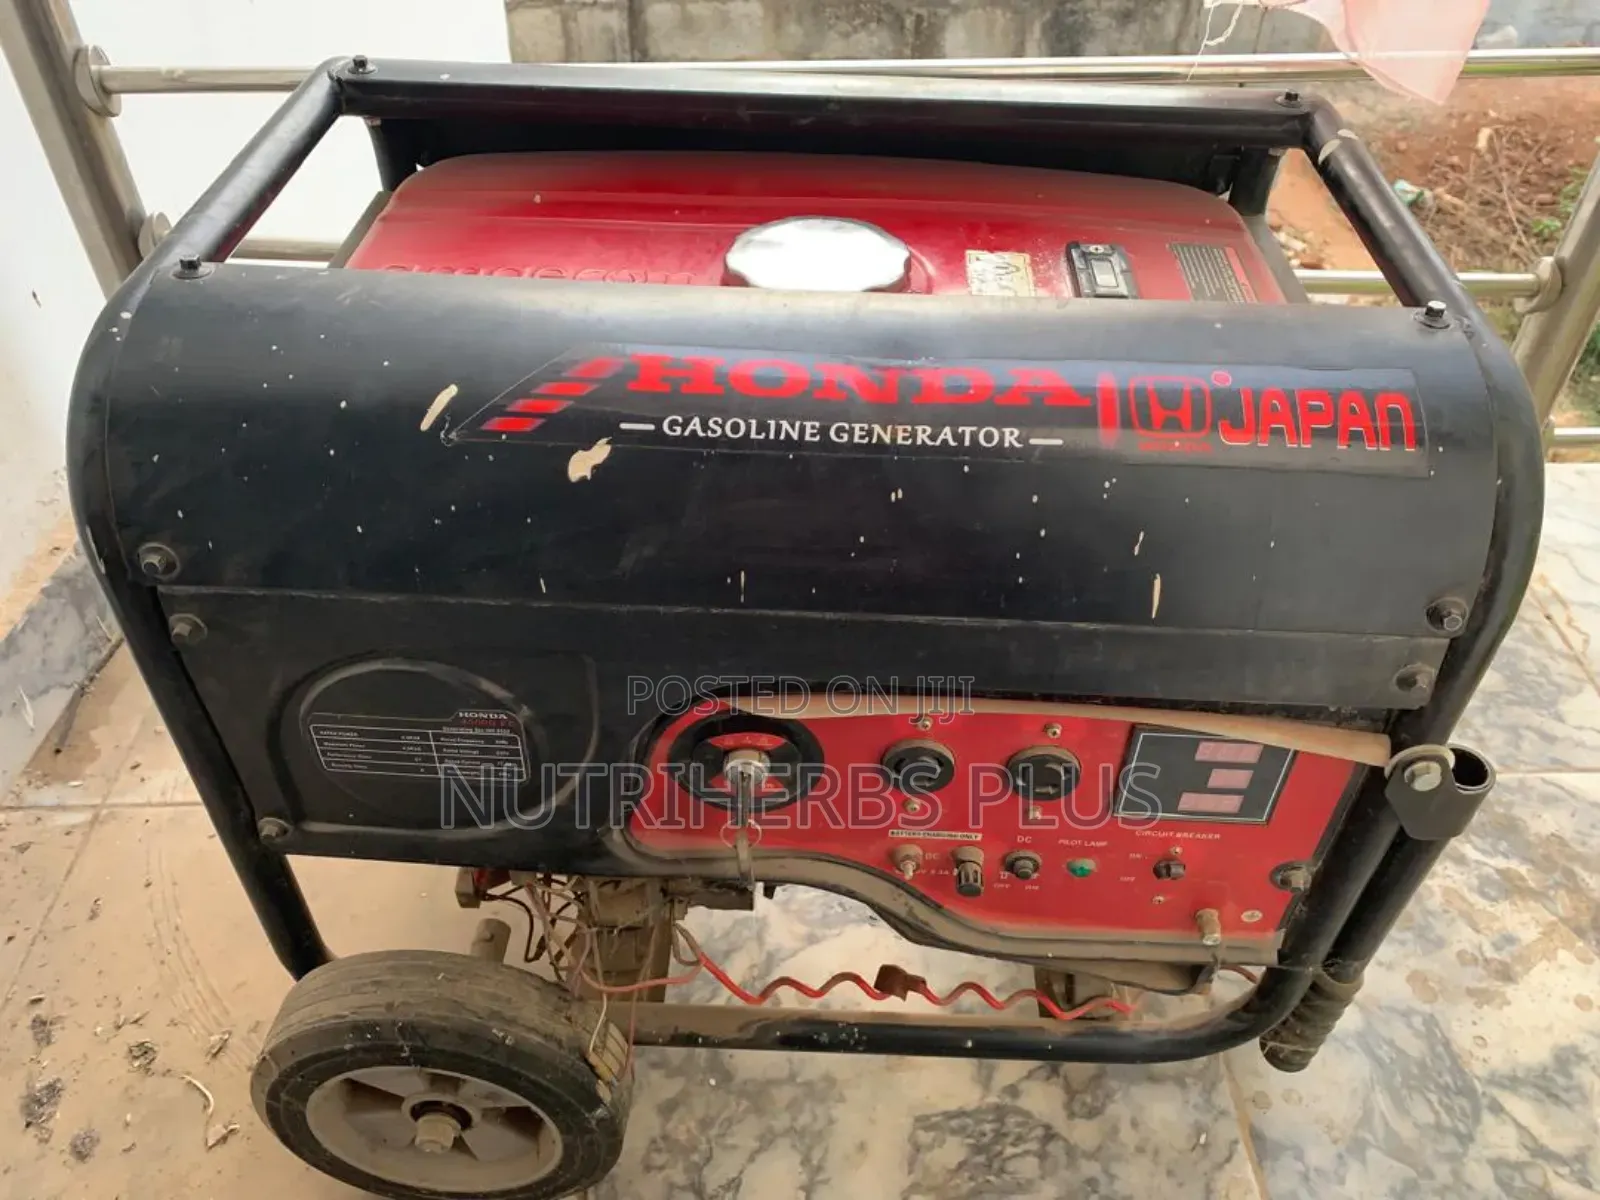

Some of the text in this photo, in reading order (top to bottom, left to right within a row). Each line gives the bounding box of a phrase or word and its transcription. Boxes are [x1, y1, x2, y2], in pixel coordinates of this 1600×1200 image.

[627, 354, 1091, 406] HONDA
[1217, 386, 1417, 451] JAPAN
[662, 415, 1024, 448] GASOLINE GENERATOR
[458, 711, 508, 719] HONDA
[1017, 835, 1032, 843] DC
[1135, 830, 1221, 840] CIRCUIT BREAKER
